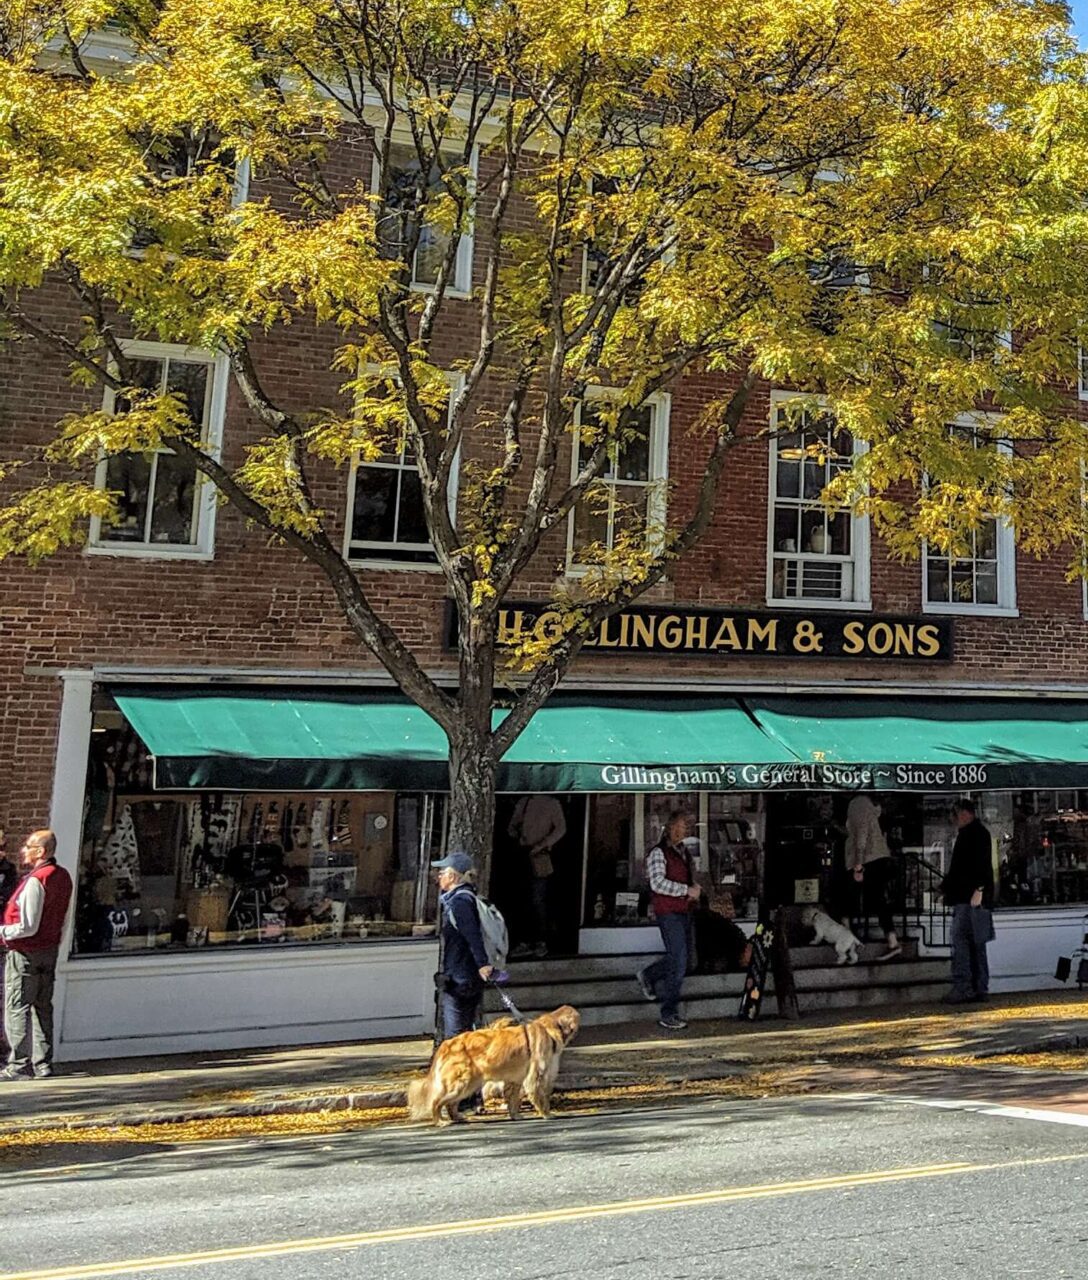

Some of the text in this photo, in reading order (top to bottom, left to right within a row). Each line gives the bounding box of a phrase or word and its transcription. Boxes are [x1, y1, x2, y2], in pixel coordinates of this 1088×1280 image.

[793, 620, 823, 652] &
[842, 621, 940, 656] SONS
[601, 765, 736, 791] Gillingham's
[742, 764, 817, 784] General
[822, 764, 871, 784] Store
[896, 764, 945, 785] Since
[950, 764, 987, 784] 1886
